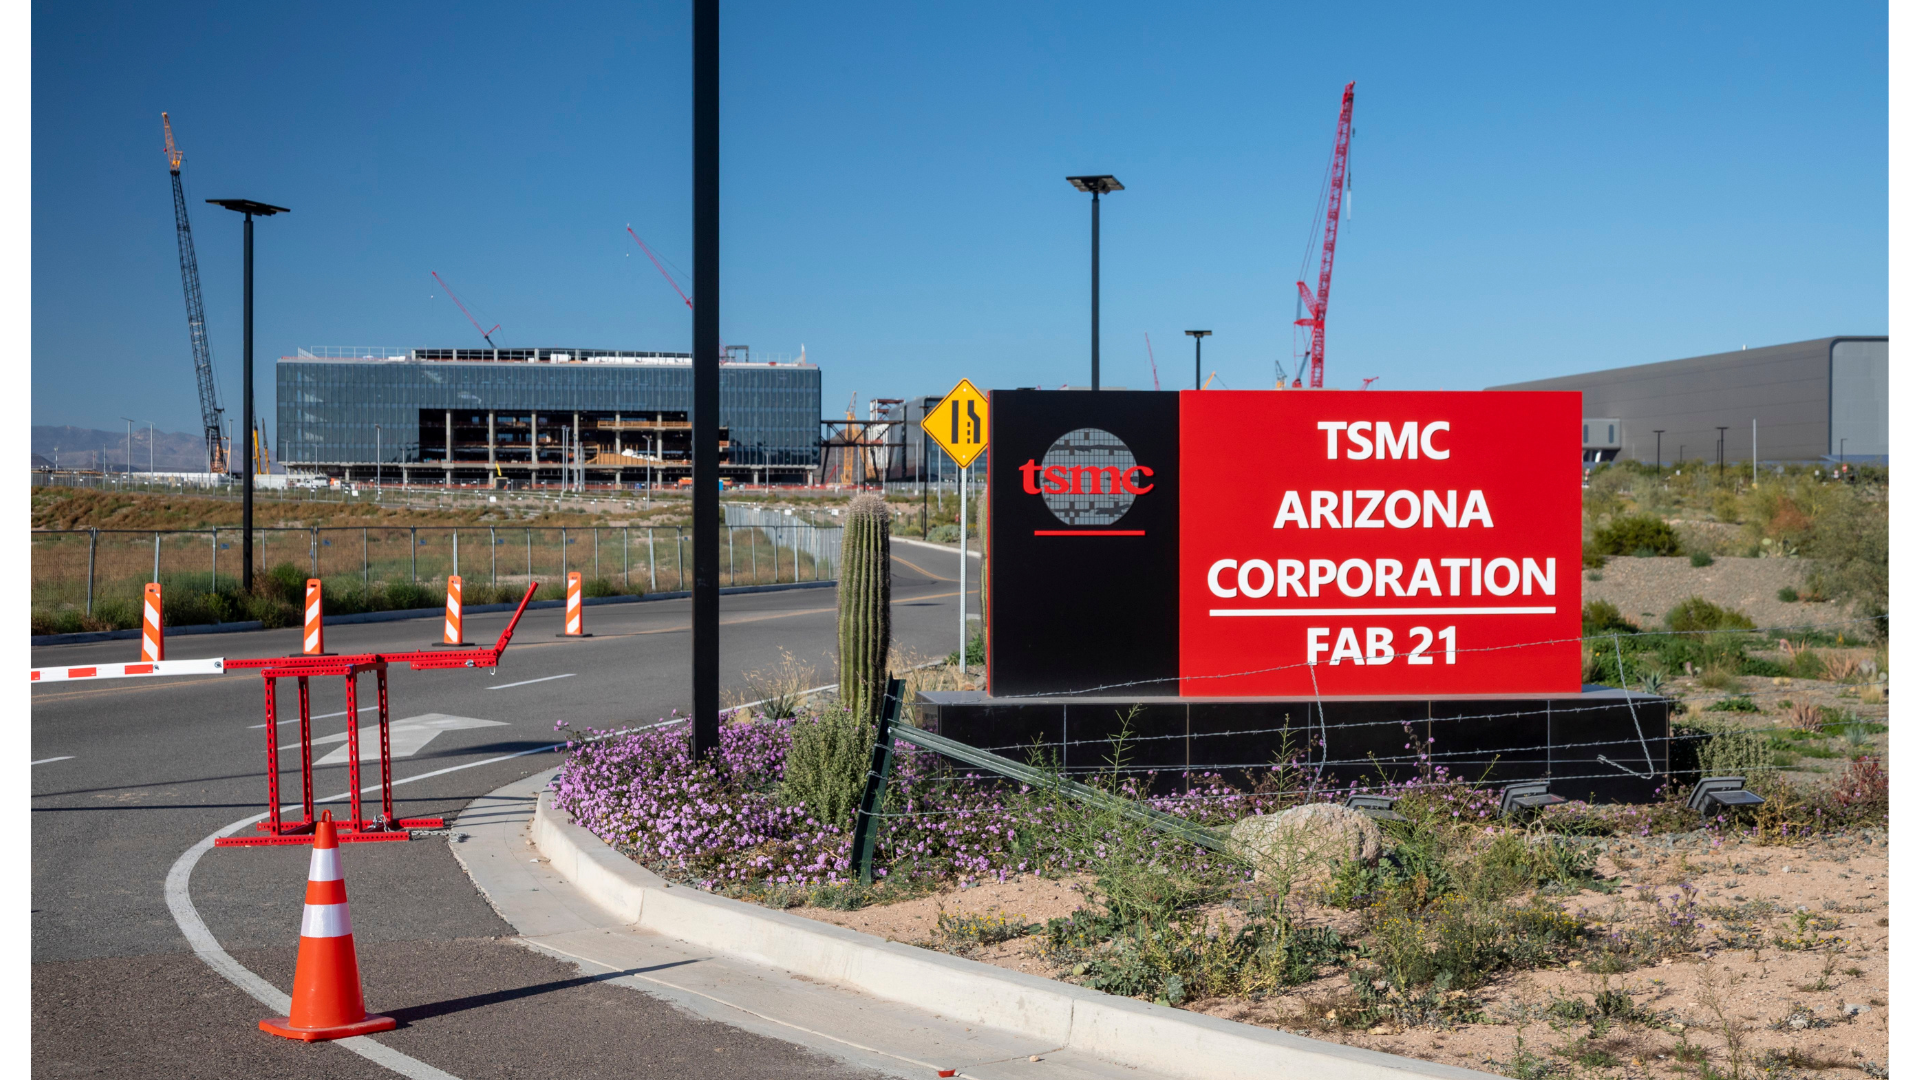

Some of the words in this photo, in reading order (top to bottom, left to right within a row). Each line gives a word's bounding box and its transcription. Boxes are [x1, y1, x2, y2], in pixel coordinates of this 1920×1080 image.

[1318, 421, 1450, 461] TSMC
[1019, 459, 1155, 496] tsmc
[1273, 490, 1494, 529] ARIZONA
[1208, 558, 1556, 599] CORPORATION
[1307, 627, 1395, 666] FAB
[1407, 626, 1456, 666] 21
